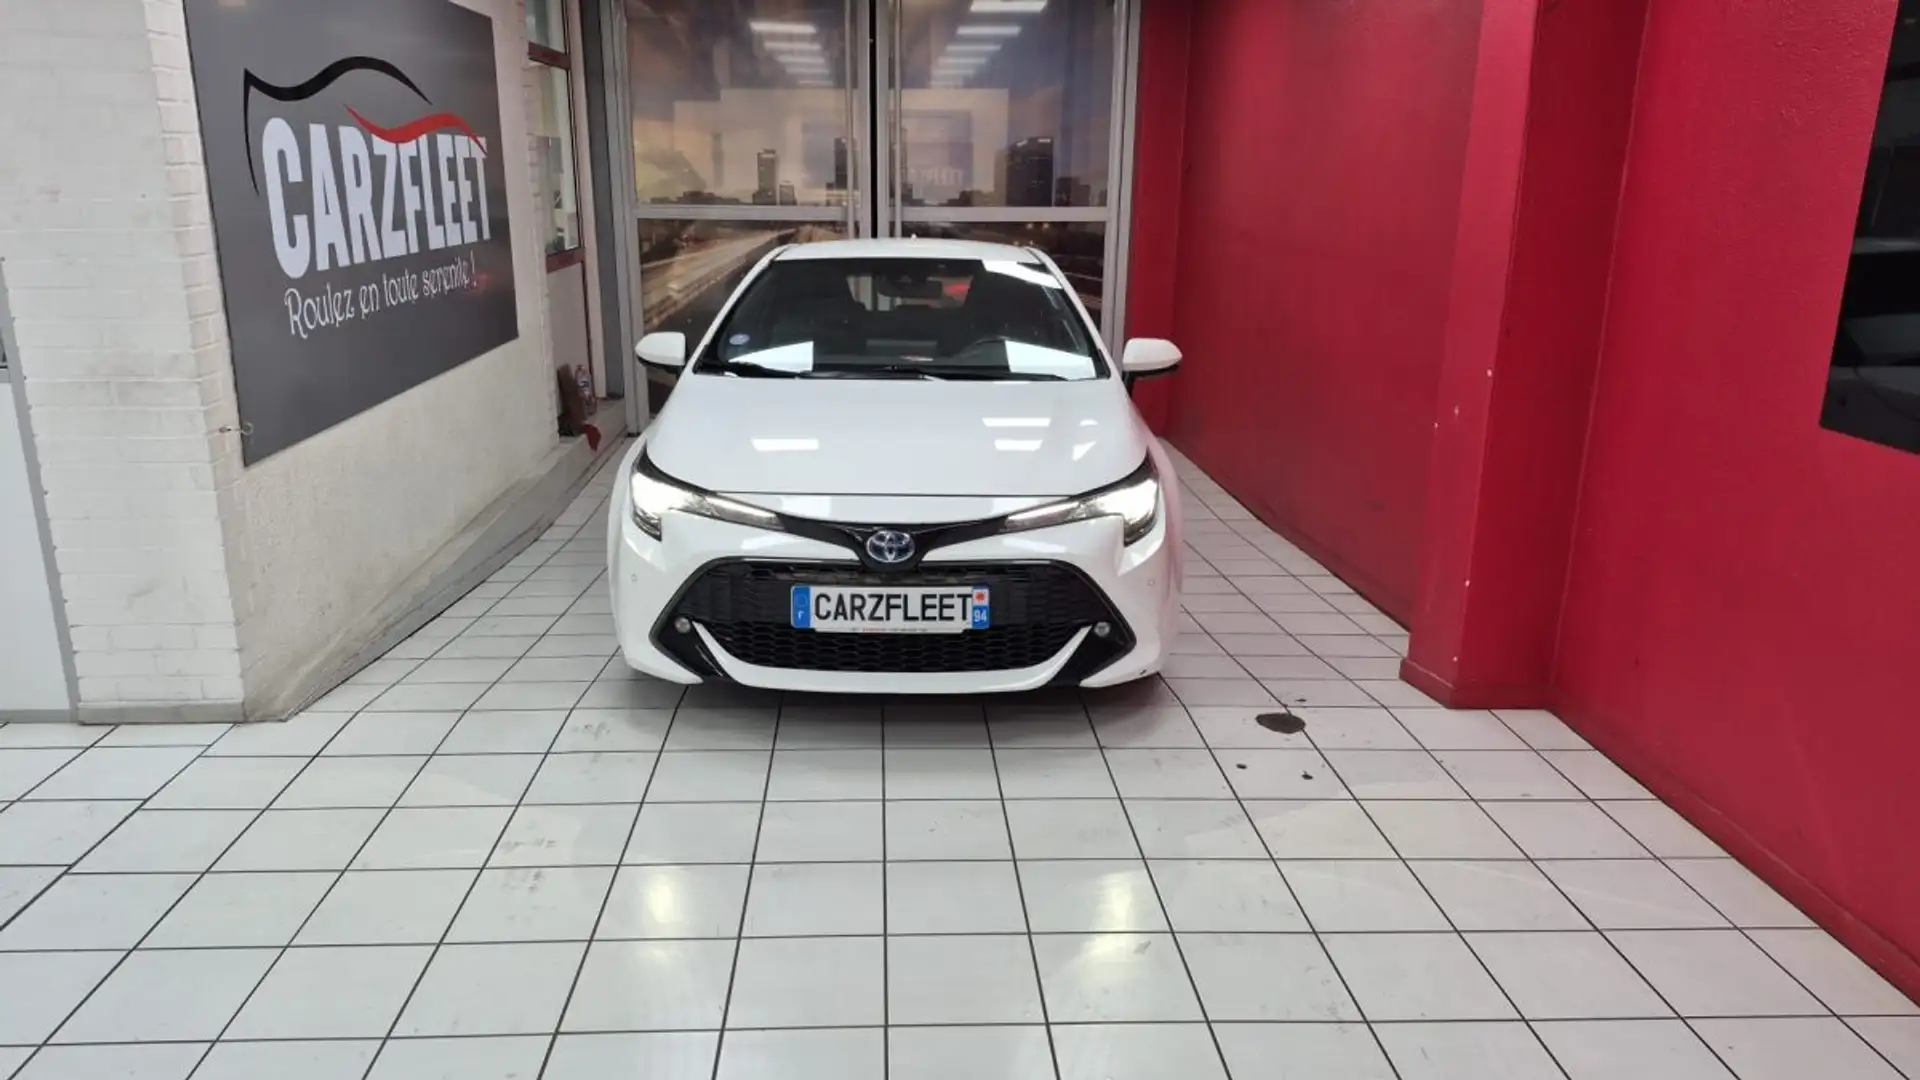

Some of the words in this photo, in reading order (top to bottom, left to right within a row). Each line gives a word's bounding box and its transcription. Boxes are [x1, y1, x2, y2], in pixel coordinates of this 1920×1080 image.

[263, 117, 491, 278] CARZFLEET
[284, 283, 355, 339] Roulez
[359, 285, 380, 319] en
[383, 269, 419, 307] toute
[815, 594, 972, 621] CARZFLEET
